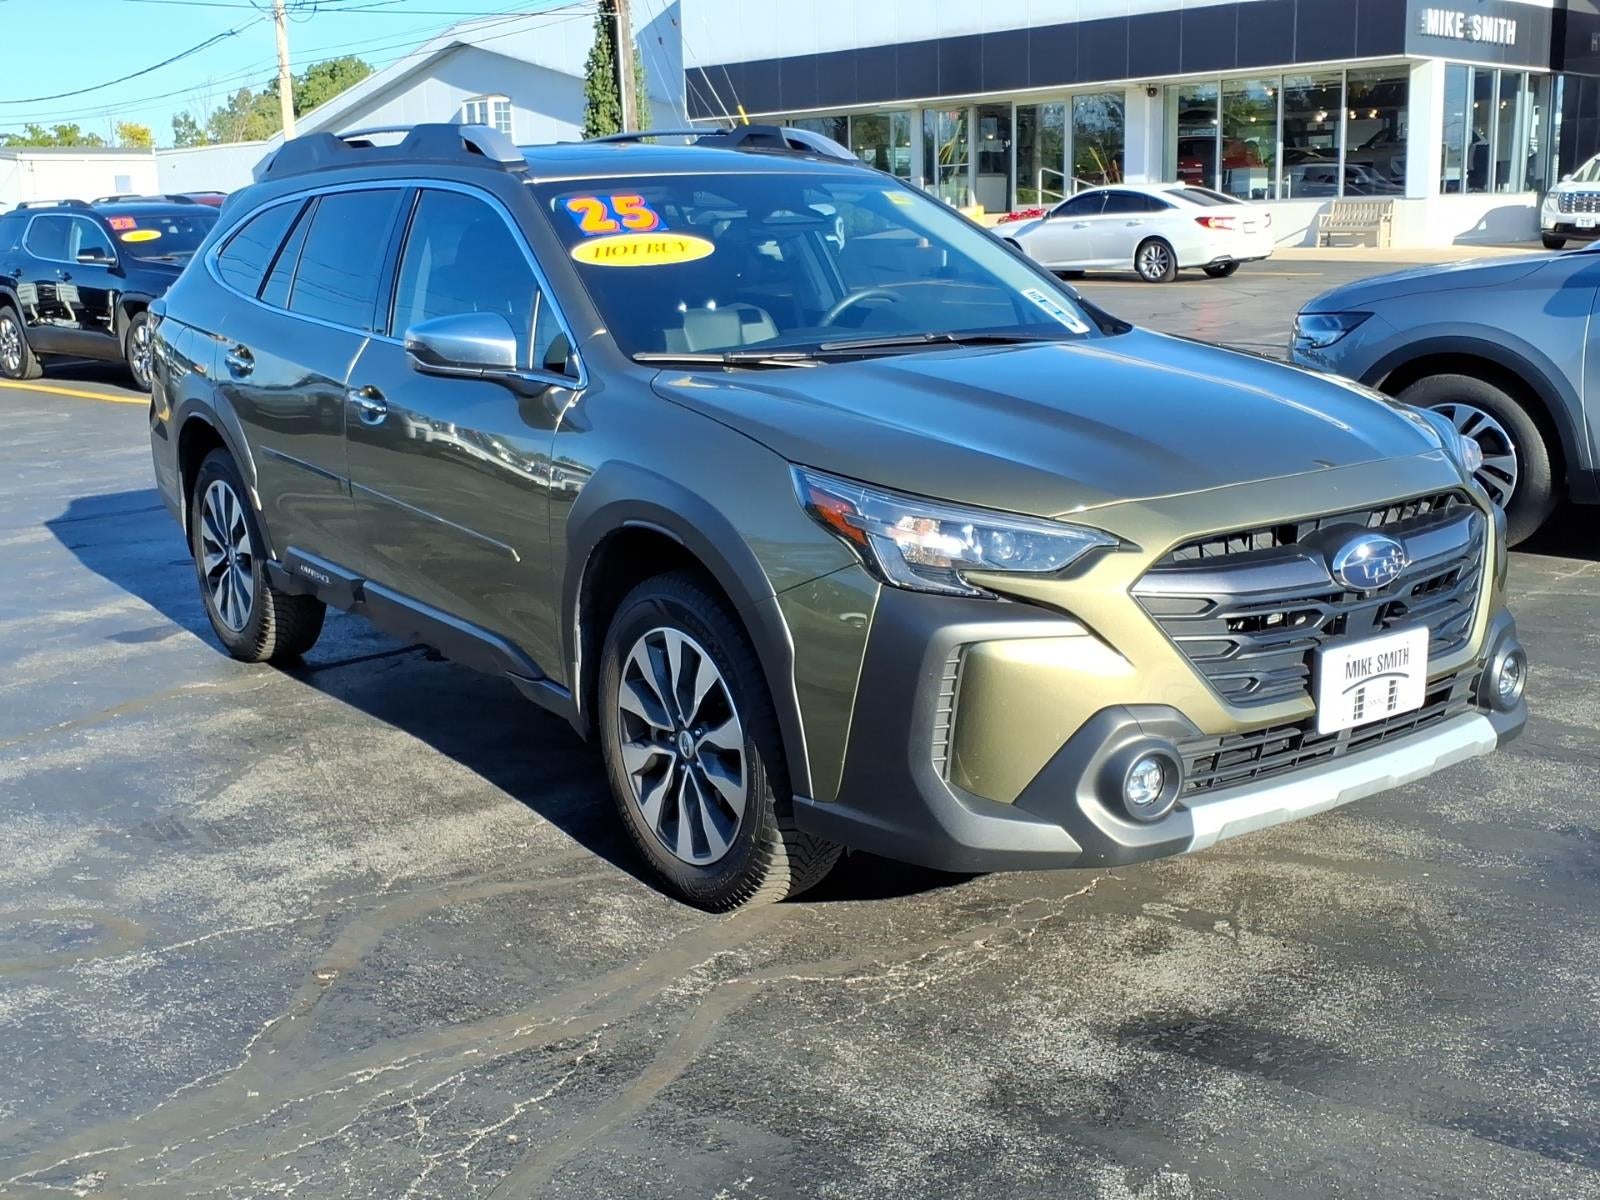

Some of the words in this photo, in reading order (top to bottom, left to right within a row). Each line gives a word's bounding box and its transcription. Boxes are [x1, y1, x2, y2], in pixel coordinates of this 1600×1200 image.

[1425, 8, 1465, 38] MIKE
[1471, 14, 1517, 46] SMITH
[567, 194, 659, 233] 25
[594, 243, 639, 258] HOT
[646, 240, 691, 255] BUY
[1345, 657, 1372, 679] MIKE
[1377, 647, 1410, 673] SMITH
